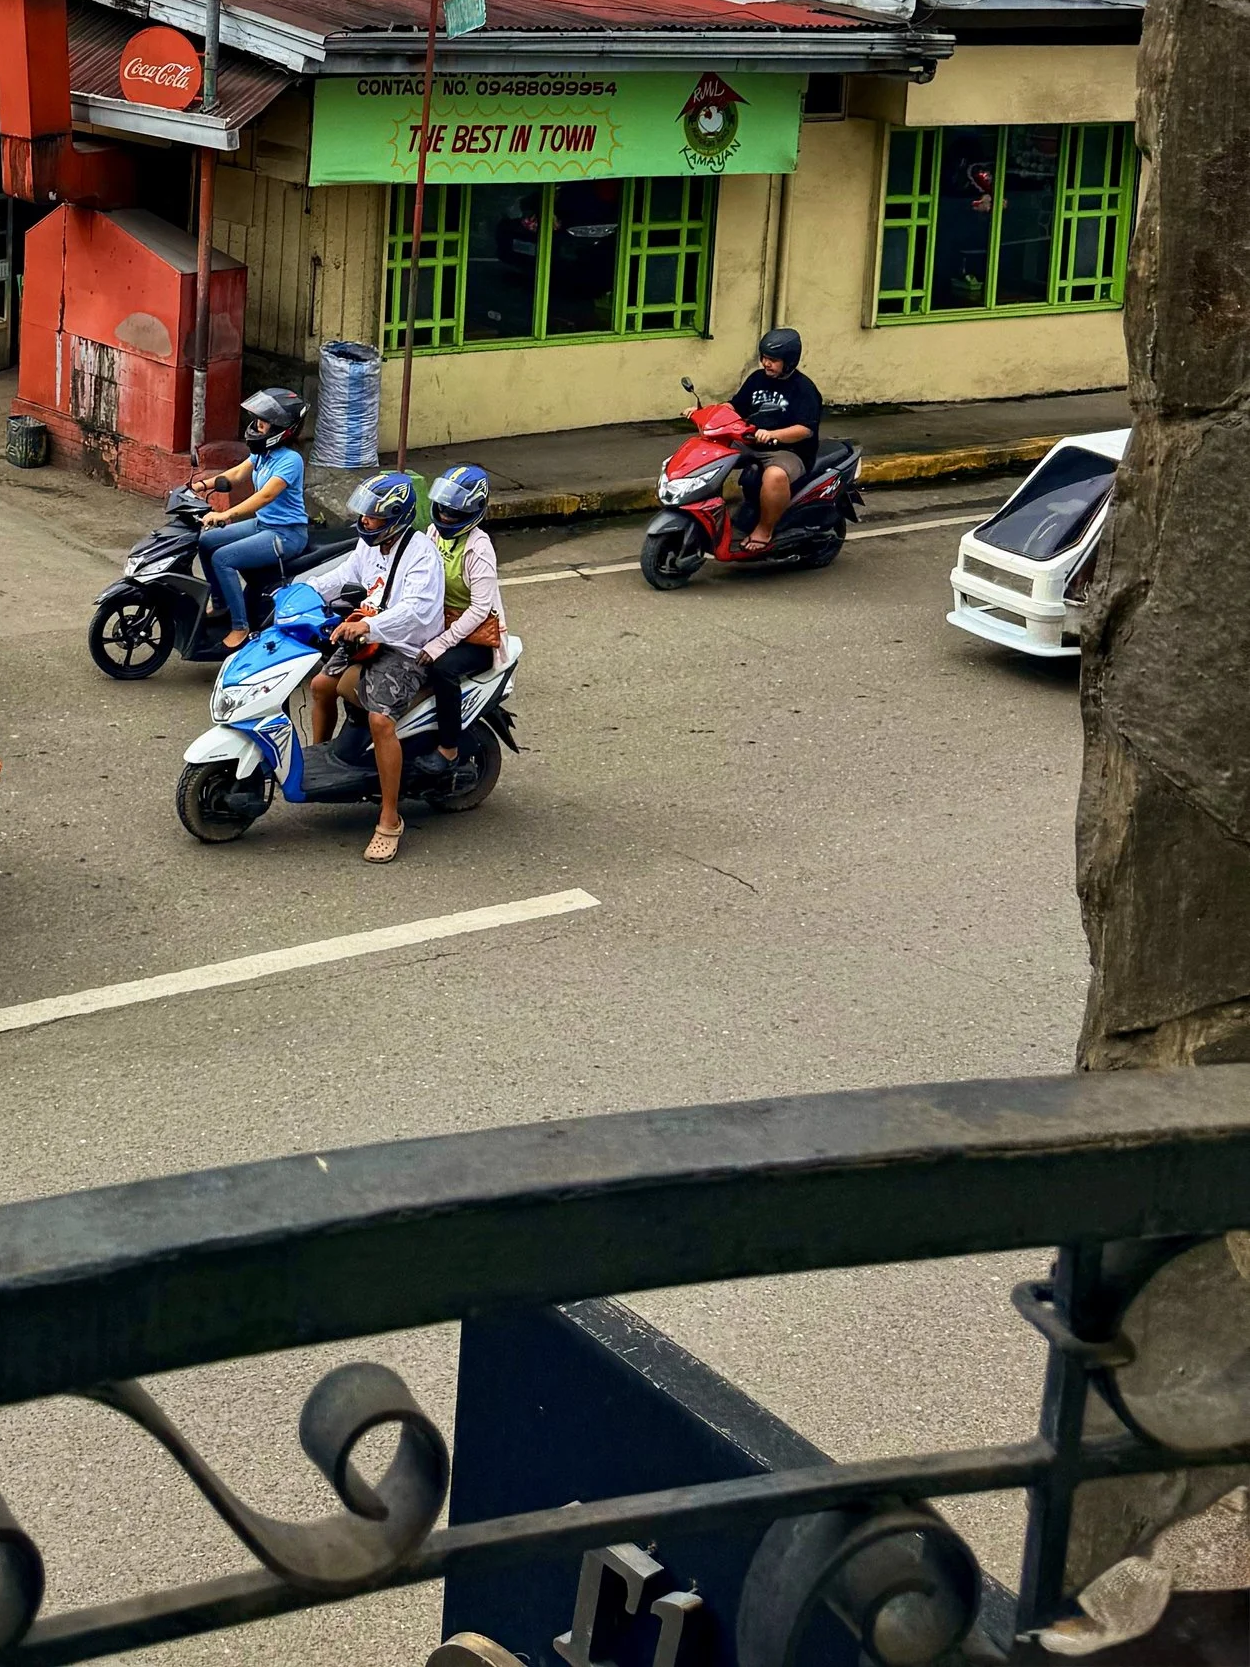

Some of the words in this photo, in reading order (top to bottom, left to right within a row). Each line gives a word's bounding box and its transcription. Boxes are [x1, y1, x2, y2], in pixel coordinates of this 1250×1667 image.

[123, 57, 195, 90] Coca-Cola
[443, 81, 469, 96] NO.
[476, 81, 617, 97] 09488099954
[693, 80, 725, 103] RML
[451, 125, 508, 154] BEST
[508, 125, 533, 154] IN
[538, 125, 598, 154] TOWN
[679, 138, 741, 173] KAMAYAN
